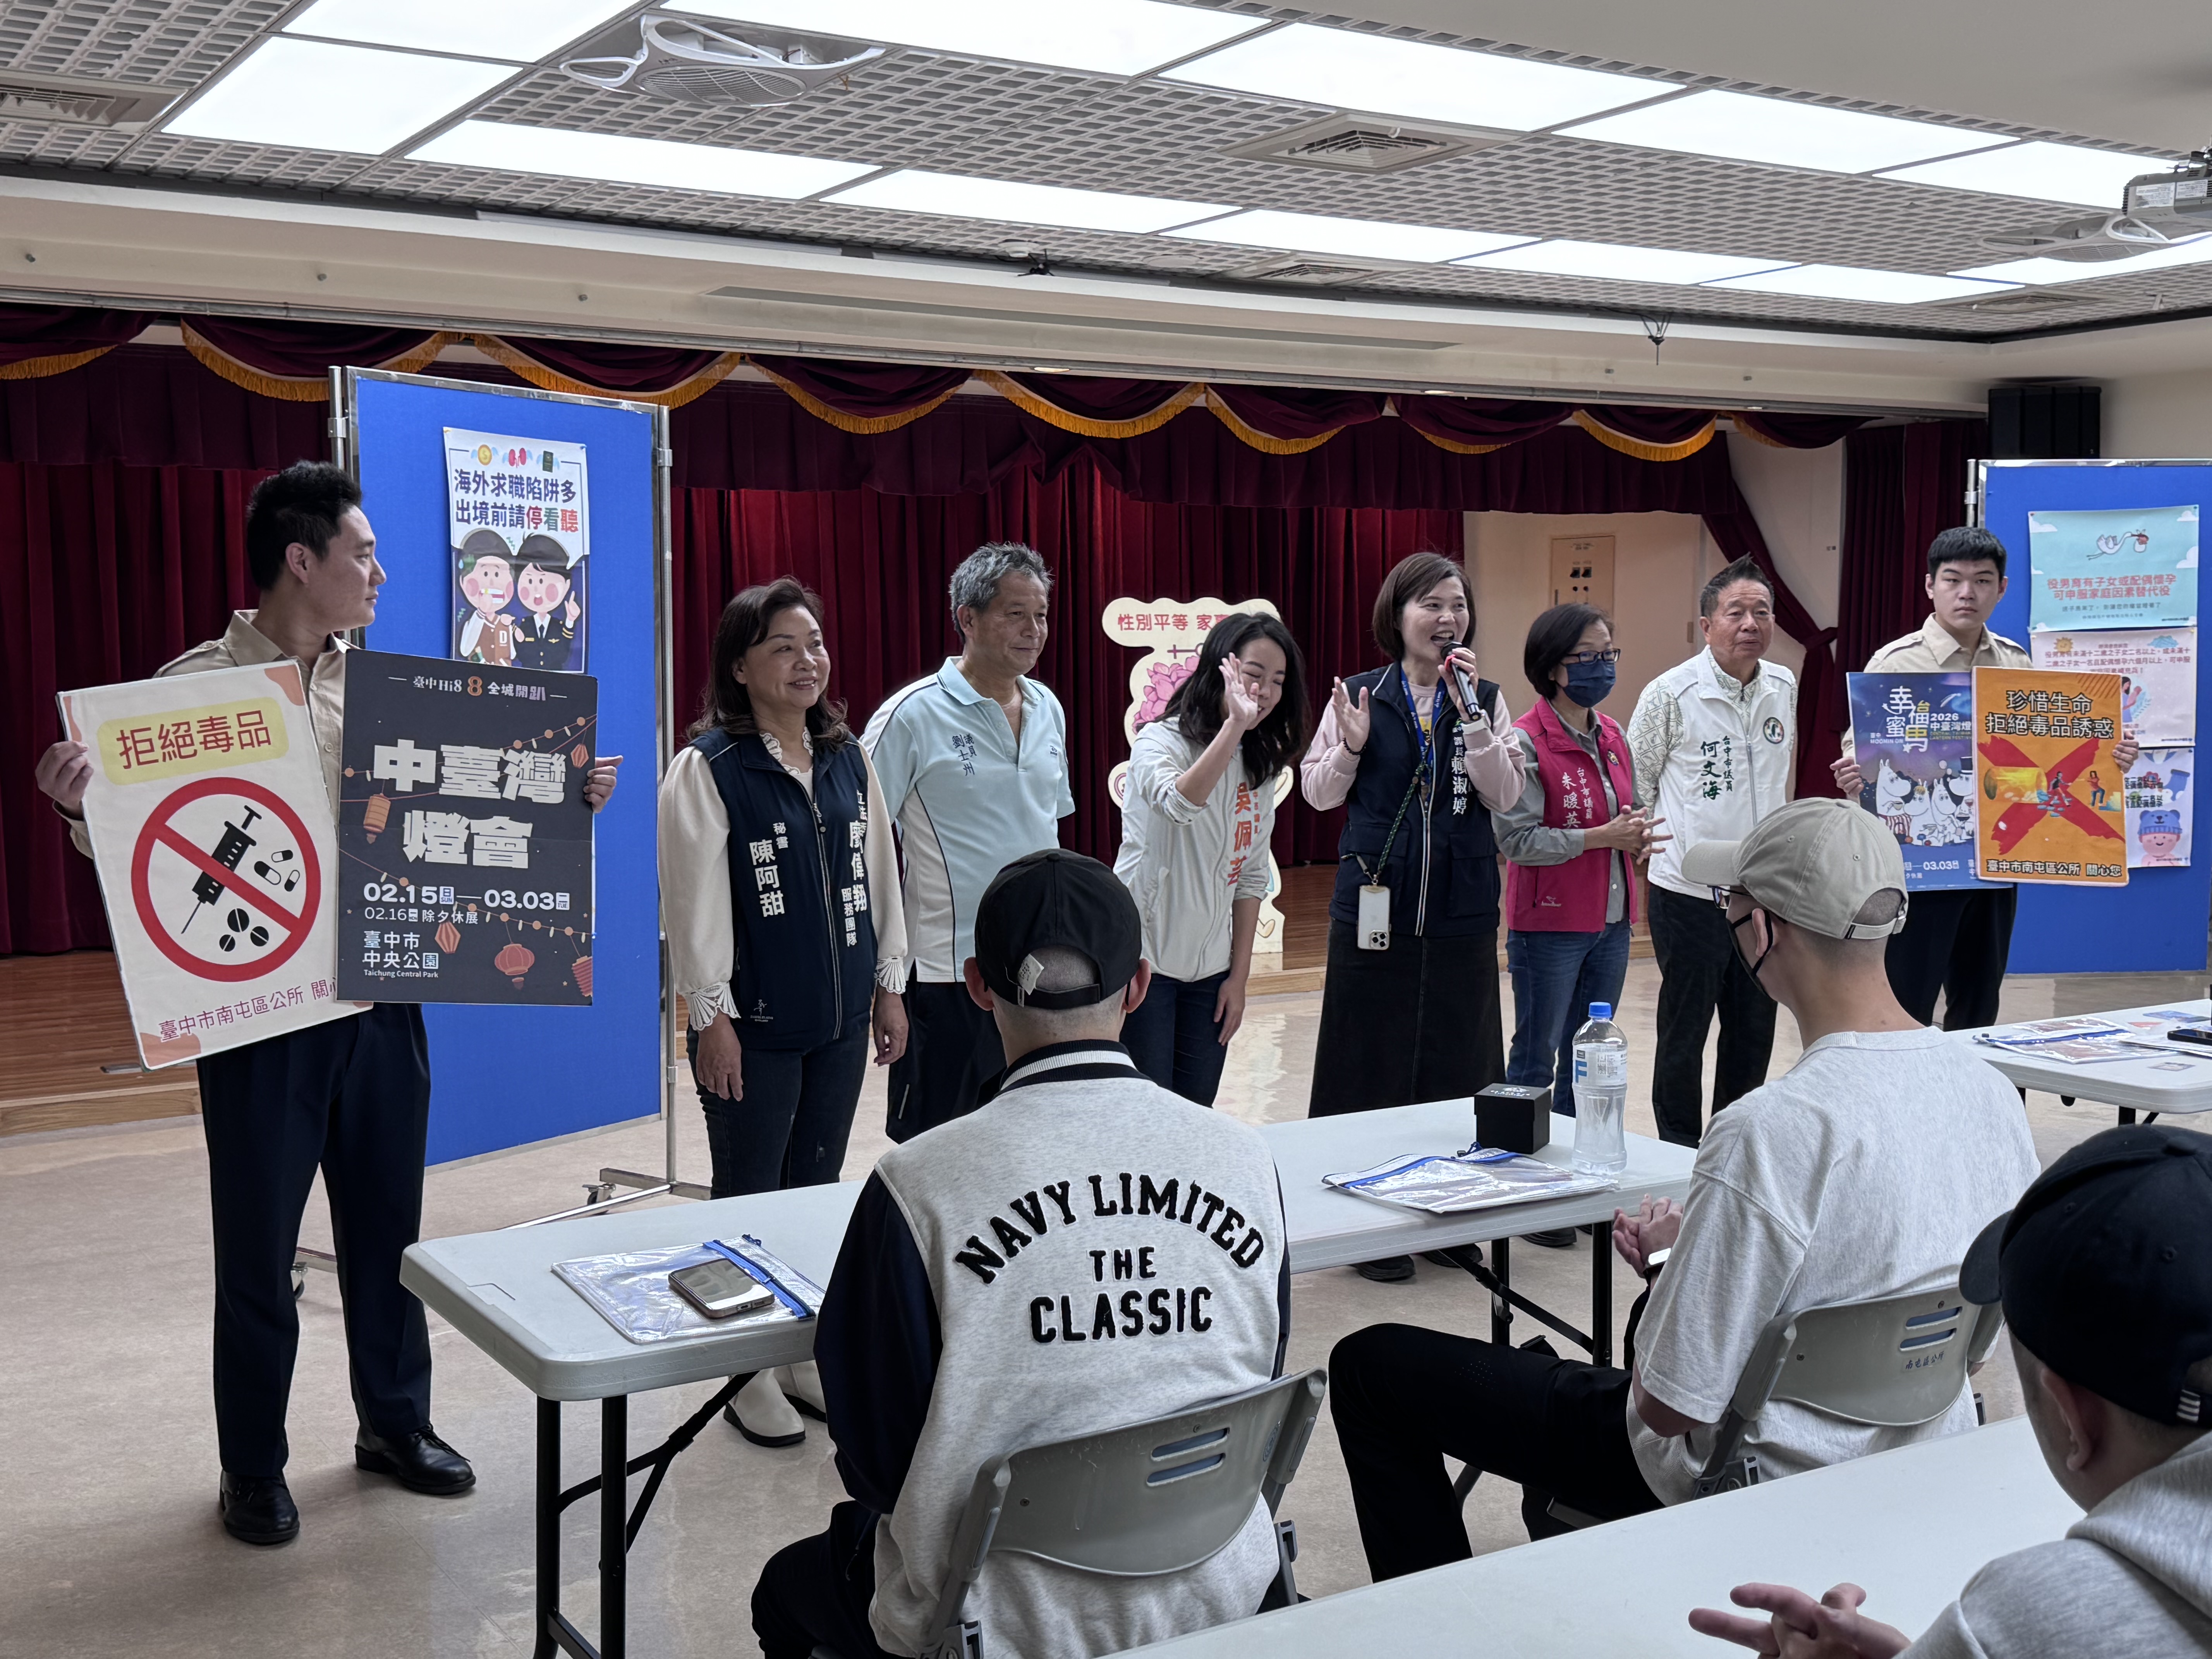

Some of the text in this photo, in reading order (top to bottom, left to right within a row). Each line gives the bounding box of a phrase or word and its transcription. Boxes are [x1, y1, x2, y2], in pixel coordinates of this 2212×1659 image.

[454, 469, 576, 503] 海外求職陷阱多
[455, 499, 579, 532] 出境前請停看聽
[1118, 614, 1188, 631] 性別平等
[488, 682, 546, 701] 全城開趴
[2006, 690, 2092, 714] 珍惜生命
[1930, 713, 1959, 721] 2026
[1985, 713, 2114, 739] 拒絕毒品誘惑
[117, 709, 271, 769] 拒絕毒品
[952, 734, 975, 776] 劉士州
[373, 738, 566, 804] 中臺灣
[1700, 741, 1722, 800] 何文海
[1561, 772, 1582, 829] 朱暖英
[402, 809, 533, 869] 燈會
[773, 822, 789, 850] 秘書
[749, 839, 785, 917] 陳阿甜
[1923, 861, 1953, 871] 03.03
[1987, 859, 2122, 877] 臺中市南屯區公所 關心您
[364, 883, 438, 904] 02.15
[484, 890, 555, 910] 03.03
[365, 907, 407, 921] 02.16
[422, 909, 478, 924] 除夕休展
[841, 887, 857, 947] 服務團隊
[364, 931, 420, 950] 臺中市
[362, 950, 439, 969] 中央公園
[364, 970, 396, 978] Taichung
[158, 986, 304, 1041] 臺中市南屯區公所
[955, 1172, 1265, 1285] NAVY LIMITED
[1089, 1246, 1157, 1283] THE
[1030, 1286, 1213, 1343] CLASSIC
